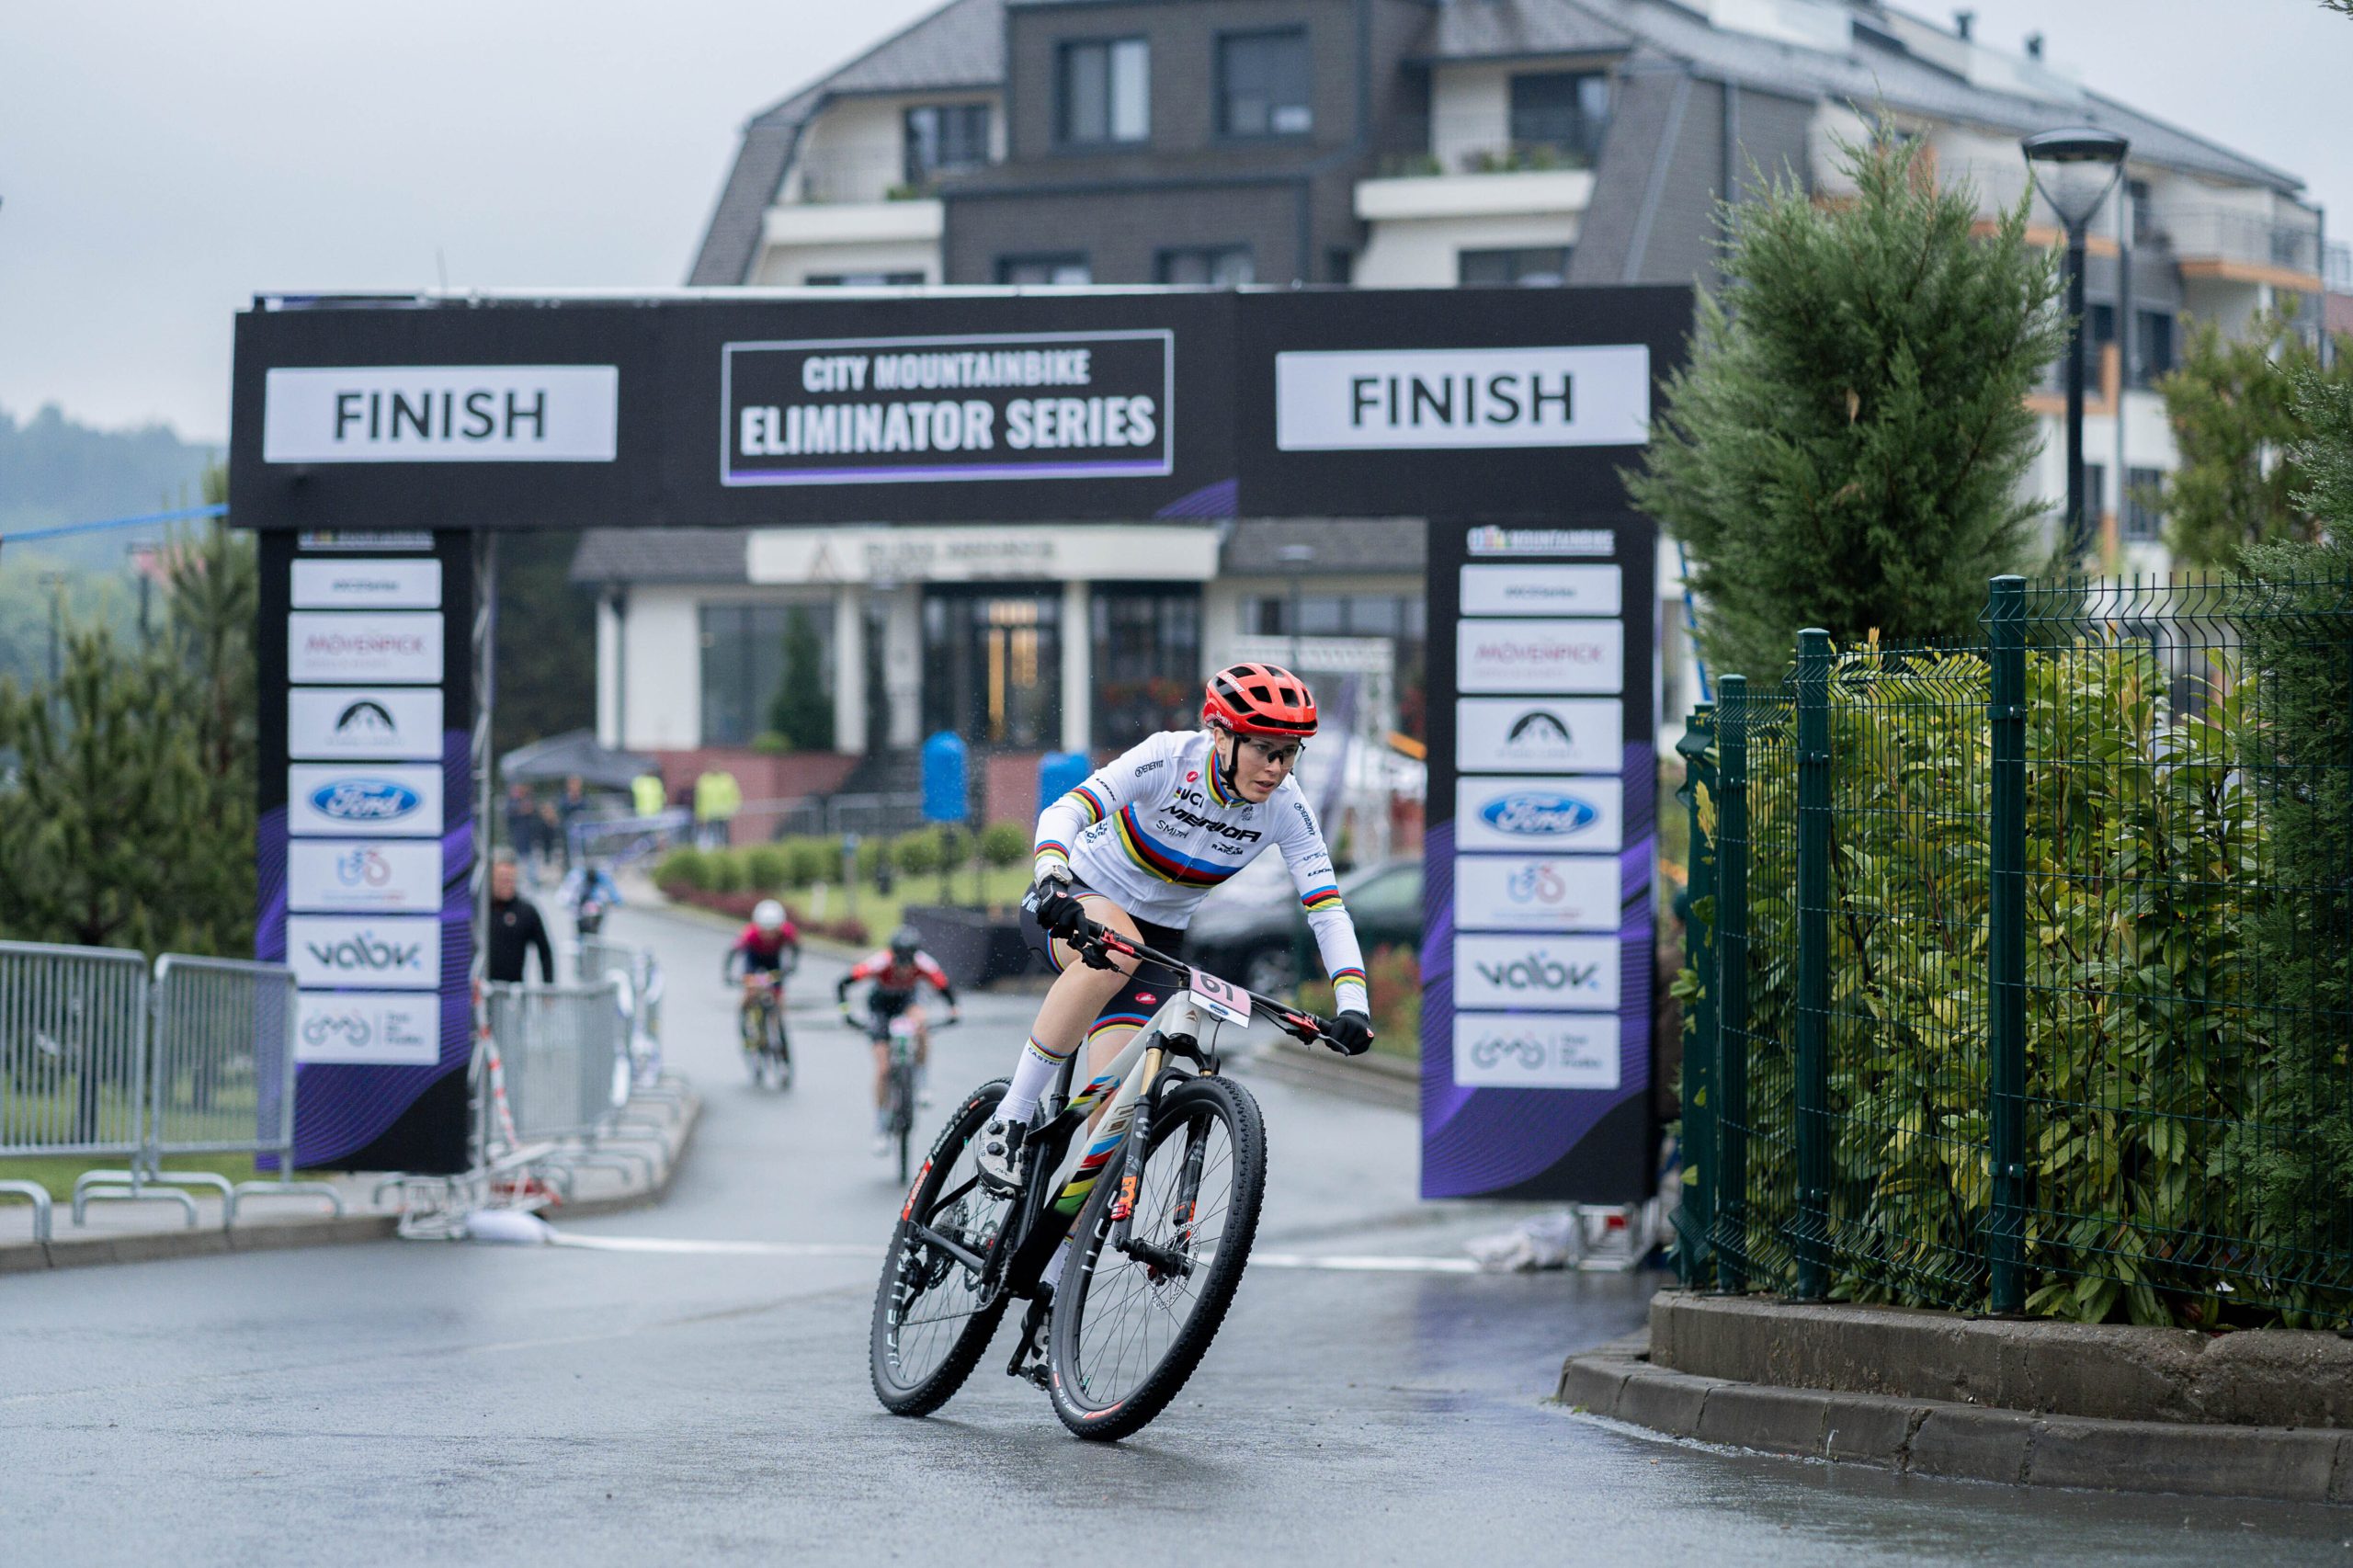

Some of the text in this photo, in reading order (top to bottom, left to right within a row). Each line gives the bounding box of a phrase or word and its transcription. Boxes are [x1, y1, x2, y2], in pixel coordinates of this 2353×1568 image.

[802, 348, 1092, 392] CITY MOUNTAINBIKE
[334, 390, 548, 441] FINISH
[1351, 372, 1576, 426] FINISH
[741, 394, 1156, 456] ELIMINATOR SERIES
[324, 781, 407, 816] Ford
[1180, 789, 1205, 809] UCI
[1495, 796, 1581, 832] Ford
[1155, 819, 1189, 839] SMITH
[1160, 805, 1263, 842] MERIDA
[1200, 974, 1233, 1002] 61
